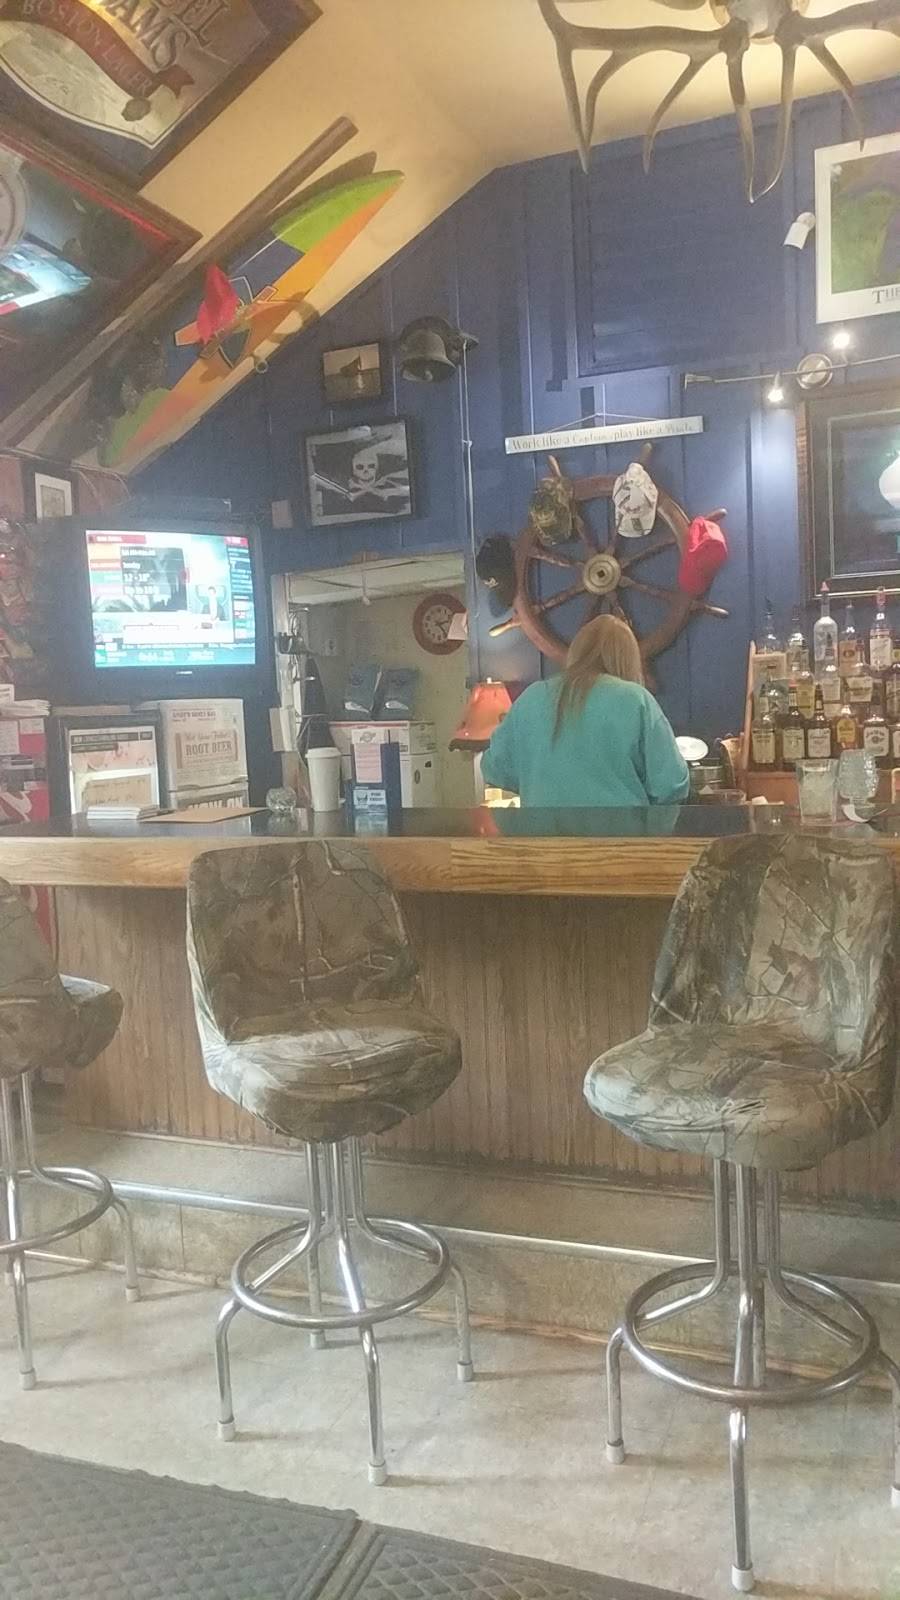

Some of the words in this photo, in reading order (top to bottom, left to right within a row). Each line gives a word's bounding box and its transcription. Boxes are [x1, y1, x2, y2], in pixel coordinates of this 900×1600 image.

[512, 435, 541, 450] Work
[542, 434, 563, 447] like
[186, 743, 210, 756] ROOT
[211, 741, 233, 753] BEER
